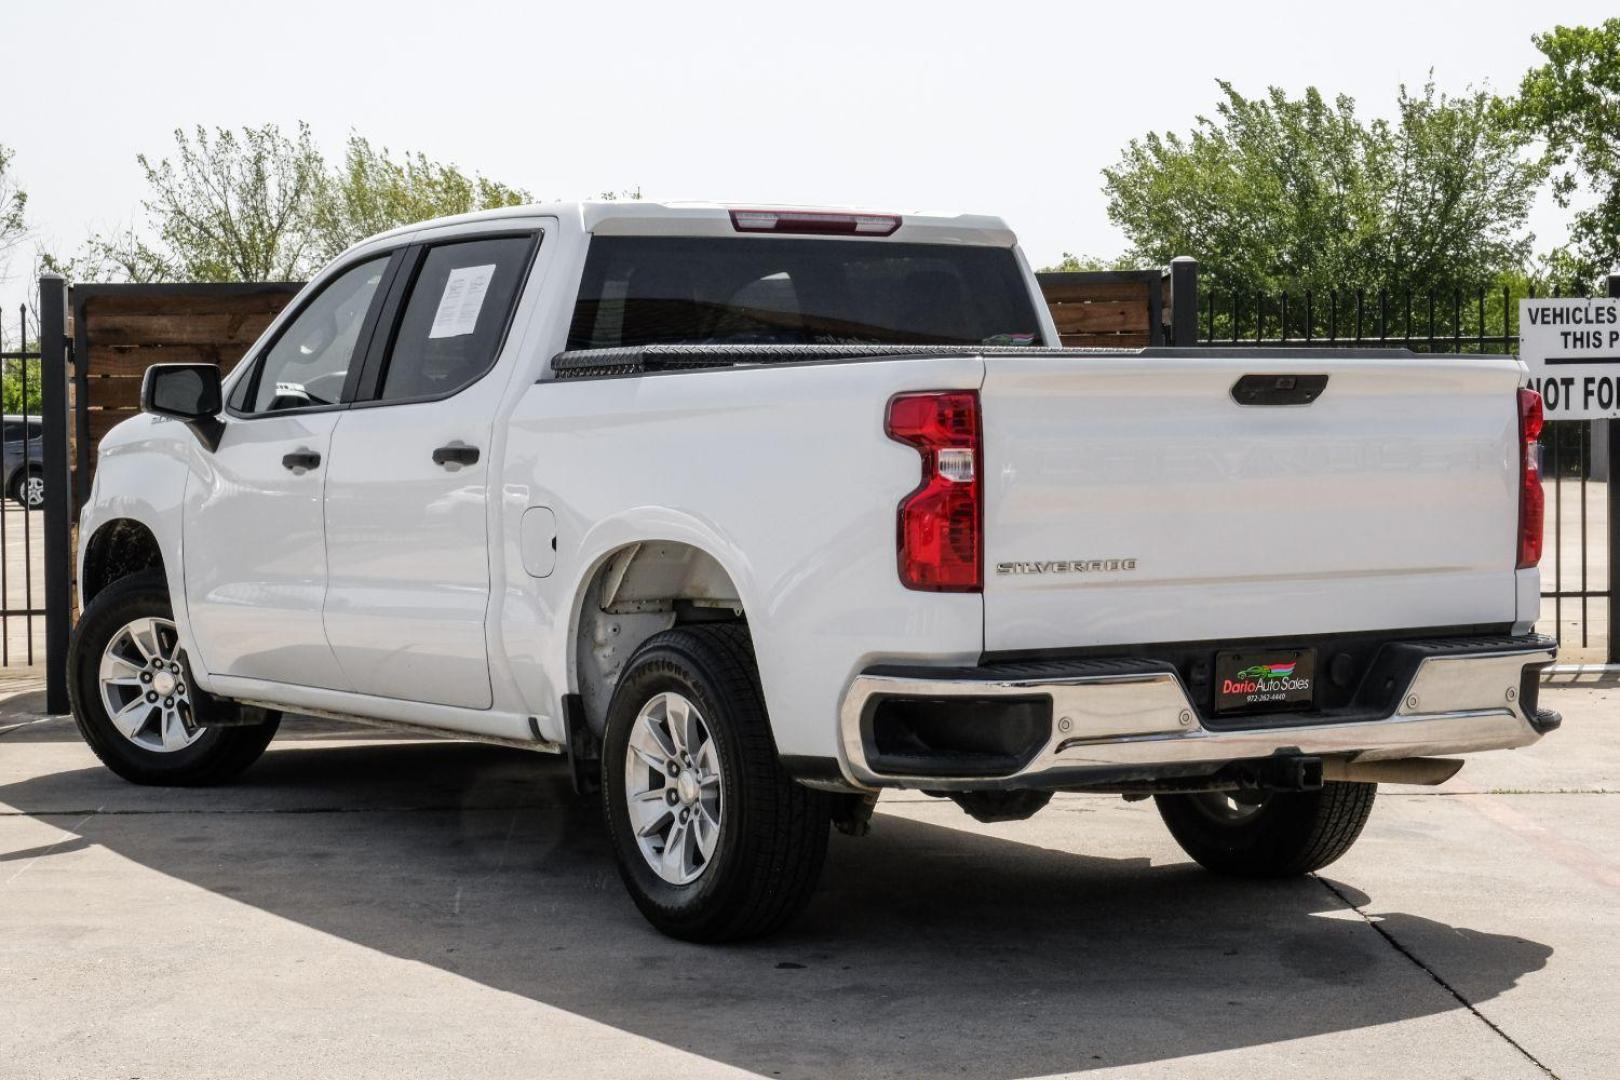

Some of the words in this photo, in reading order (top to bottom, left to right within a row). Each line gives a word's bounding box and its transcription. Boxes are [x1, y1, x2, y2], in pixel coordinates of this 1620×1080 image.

[1527, 306, 1617, 325] VEHICLES
[1560, 331, 1603, 349] THIS
[1583, 376, 1620, 411] FO
[996, 558, 1137, 576] SILVERADO
